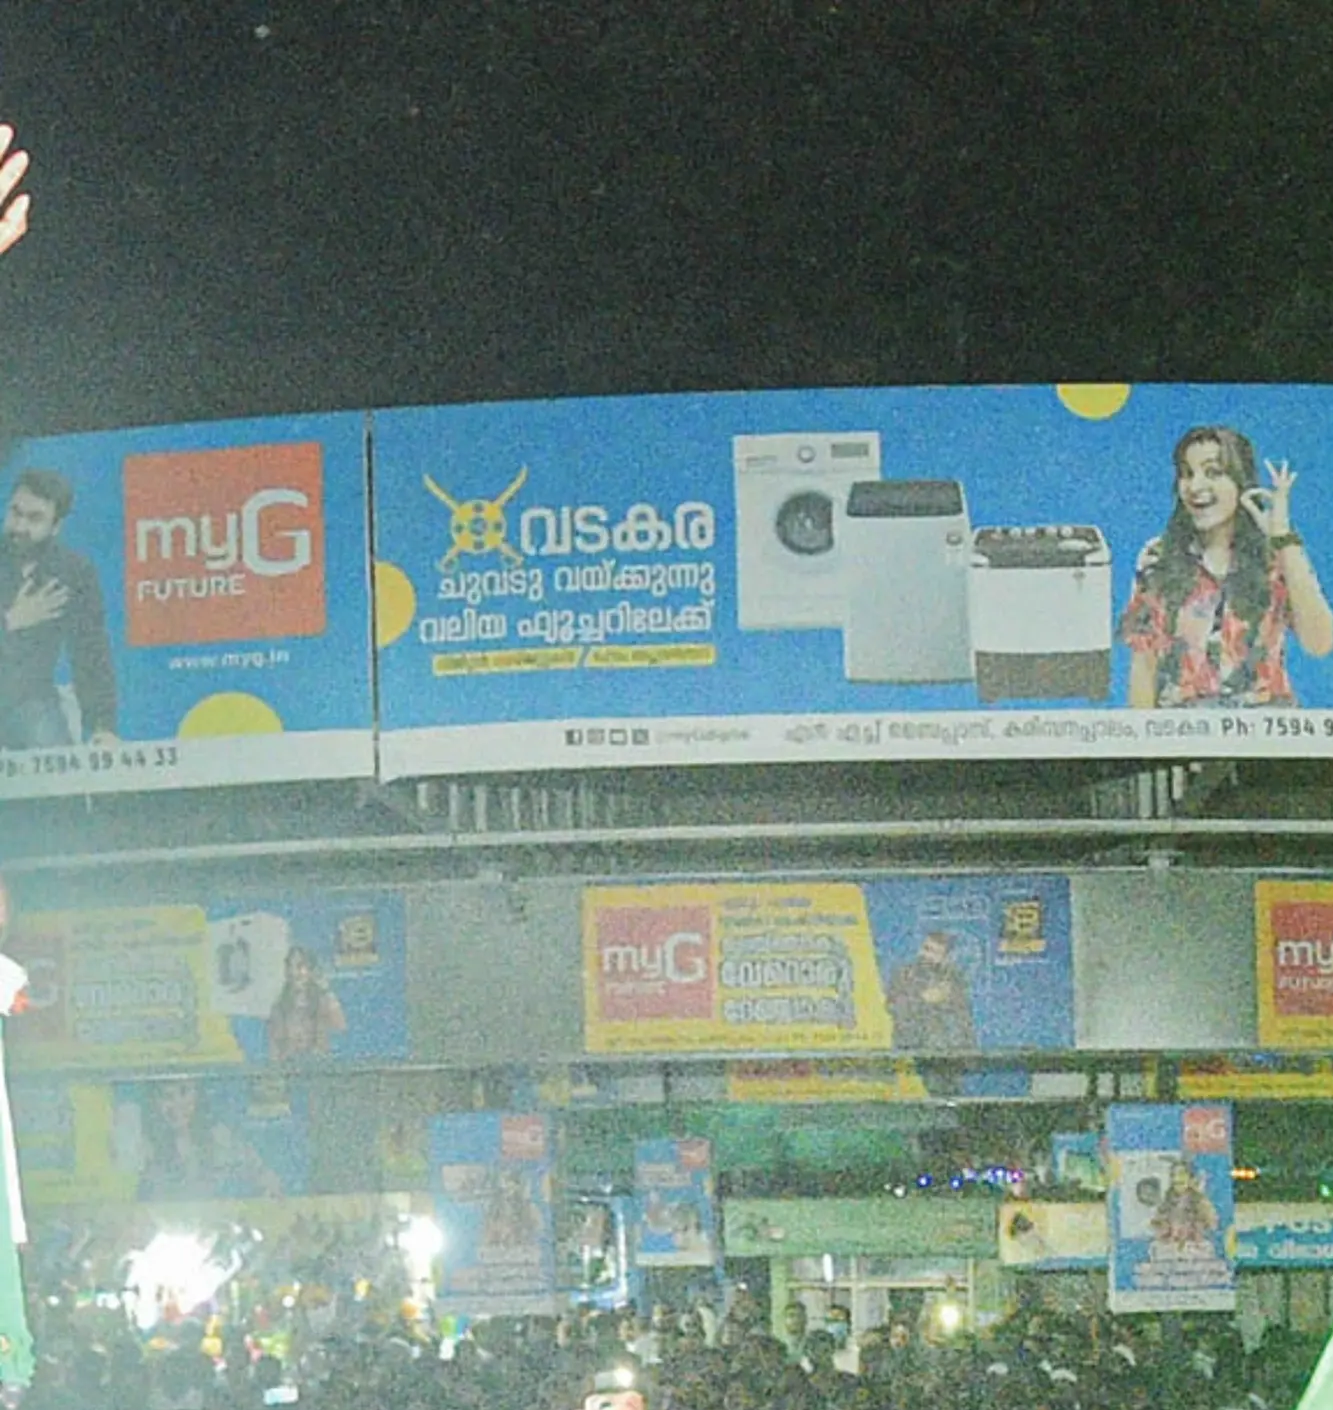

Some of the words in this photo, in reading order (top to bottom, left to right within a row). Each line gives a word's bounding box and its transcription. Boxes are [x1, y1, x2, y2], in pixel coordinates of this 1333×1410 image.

[135, 487, 311, 577] myG
[519, 502, 715, 556] വടകര
[137, 574, 246, 602] FUTURE
[437, 568, 544, 605] ചുവടു
[554, 558, 716, 597] വയ്ക്കുന്നു
[419, 607, 508, 644] വലിയ
[1263, 716, 1316, 737] 7594
[153, 746, 179, 768] 33
[602, 933, 706, 983] myG
